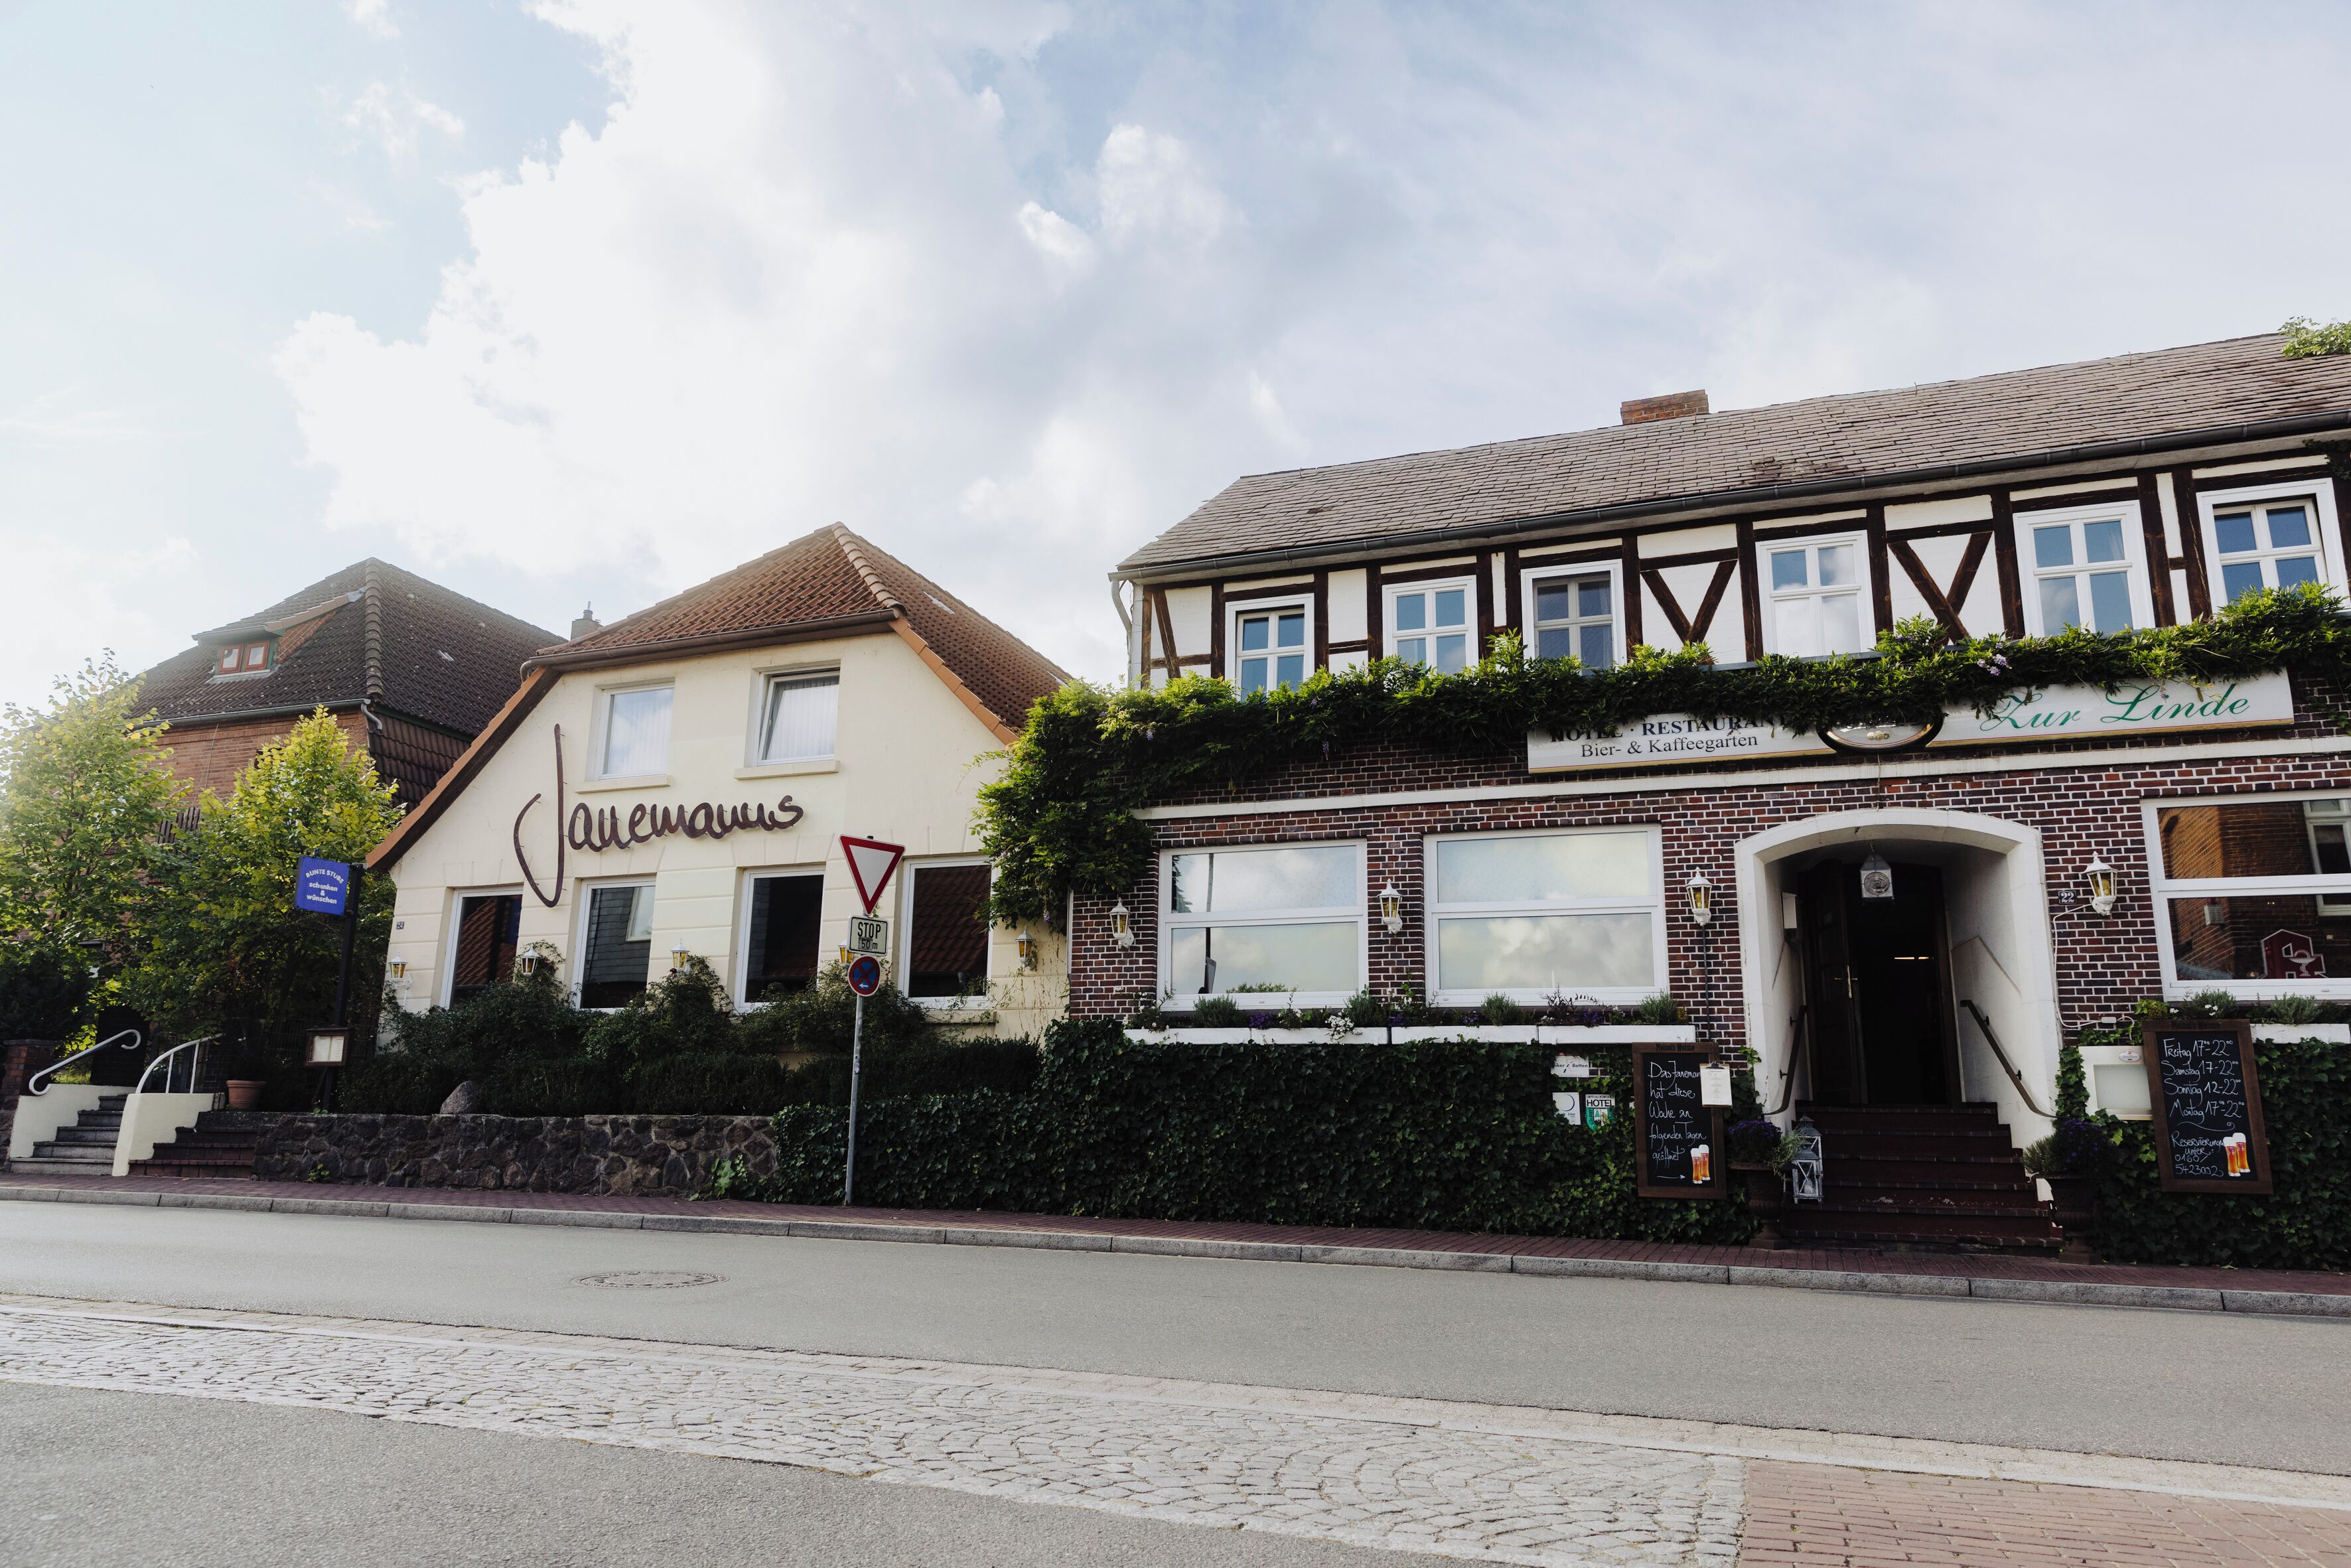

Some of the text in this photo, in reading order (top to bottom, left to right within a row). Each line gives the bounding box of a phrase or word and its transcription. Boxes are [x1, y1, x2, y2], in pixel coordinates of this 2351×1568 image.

[1979, 683, 2250, 731] Zur Linde
[1581, 735, 1758, 757] Bier- & Kaffeegarten
[305, 869, 344, 884] BUNTE STUBE
[309, 882, 338, 892] schenken
[307, 894, 337, 904] wünschen
[2060, 892, 2075, 902] 22
[857, 922, 881, 939] STOP
[861, 939, 871, 949] 50
[1648, 1062, 1672, 1078] Das
[2161, 1060, 2200, 1083] Samstag
[1650, 1080, 1665, 1098] hat
[1668, 1083, 1695, 1099] diese
[2164, 1078, 2202, 1107] Sonntag
[1649, 1101, 1693, 1119] Woche an
[2169, 1098, 2204, 1125] Montag
[1649, 1121, 1707, 1151] folgenden Tagen
[1652, 1145, 1685, 1170] geöffnet
